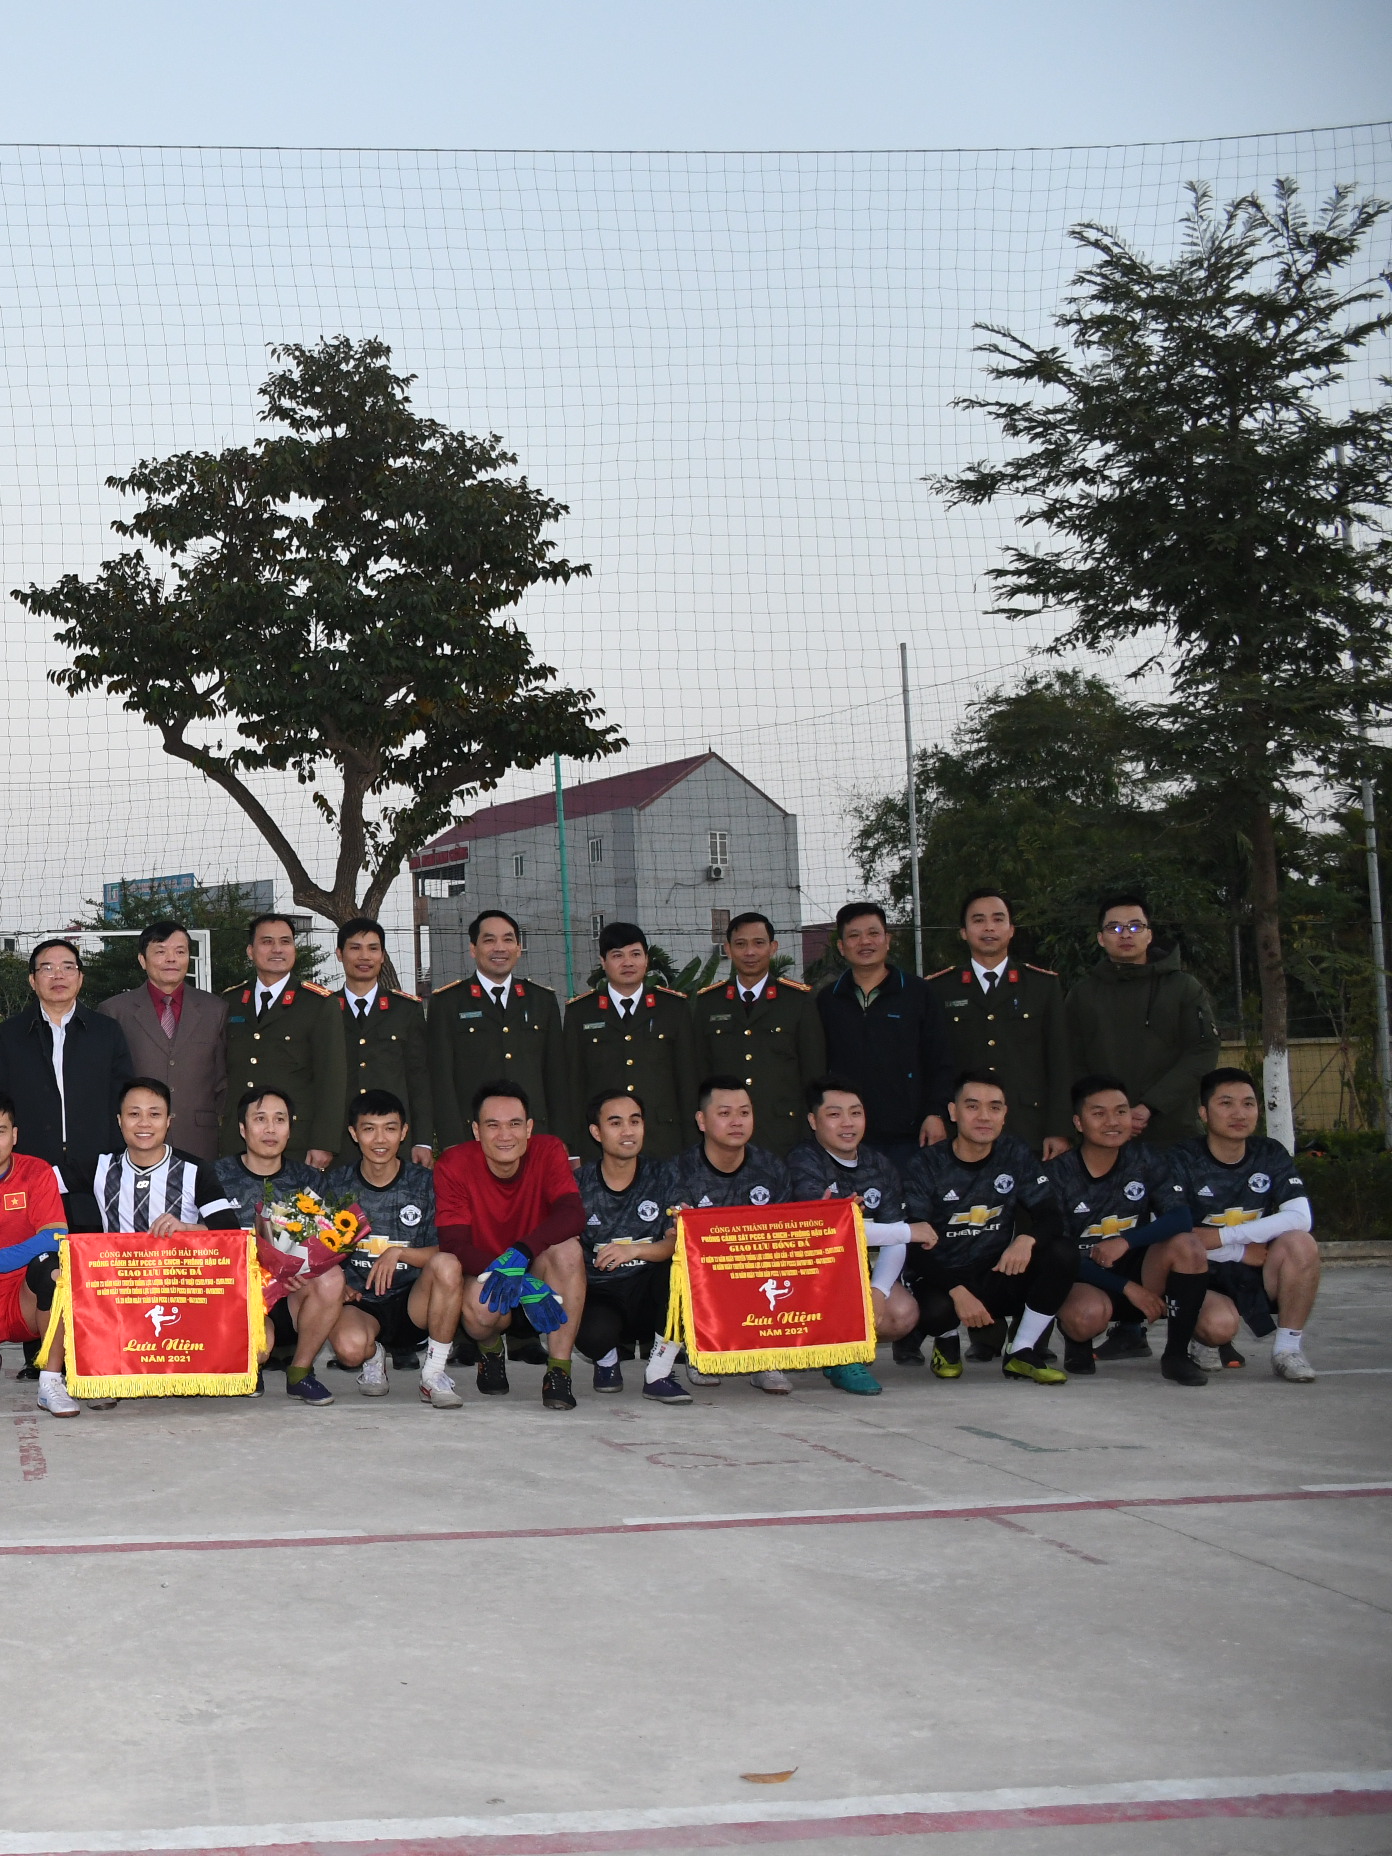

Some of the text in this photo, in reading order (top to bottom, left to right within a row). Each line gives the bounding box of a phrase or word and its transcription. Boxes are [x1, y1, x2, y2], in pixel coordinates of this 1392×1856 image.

[772, 1240, 796, 1249] BÓNG
[100, 1250, 120, 1258] CÔNG
[134, 1249, 160, 1257] THÀNH
[161, 1247, 177, 1256] PHỐ
[179, 1247, 191, 1256] HẢI
[143, 1268, 160, 1276] LƯU
[163, 1267, 187, 1276] BÓNG
[742, 1311, 823, 1326] Lưu Niệm
[759, 1327, 808, 1336] NĂM 2021
[123, 1338, 205, 1354] Lưu Niệm
